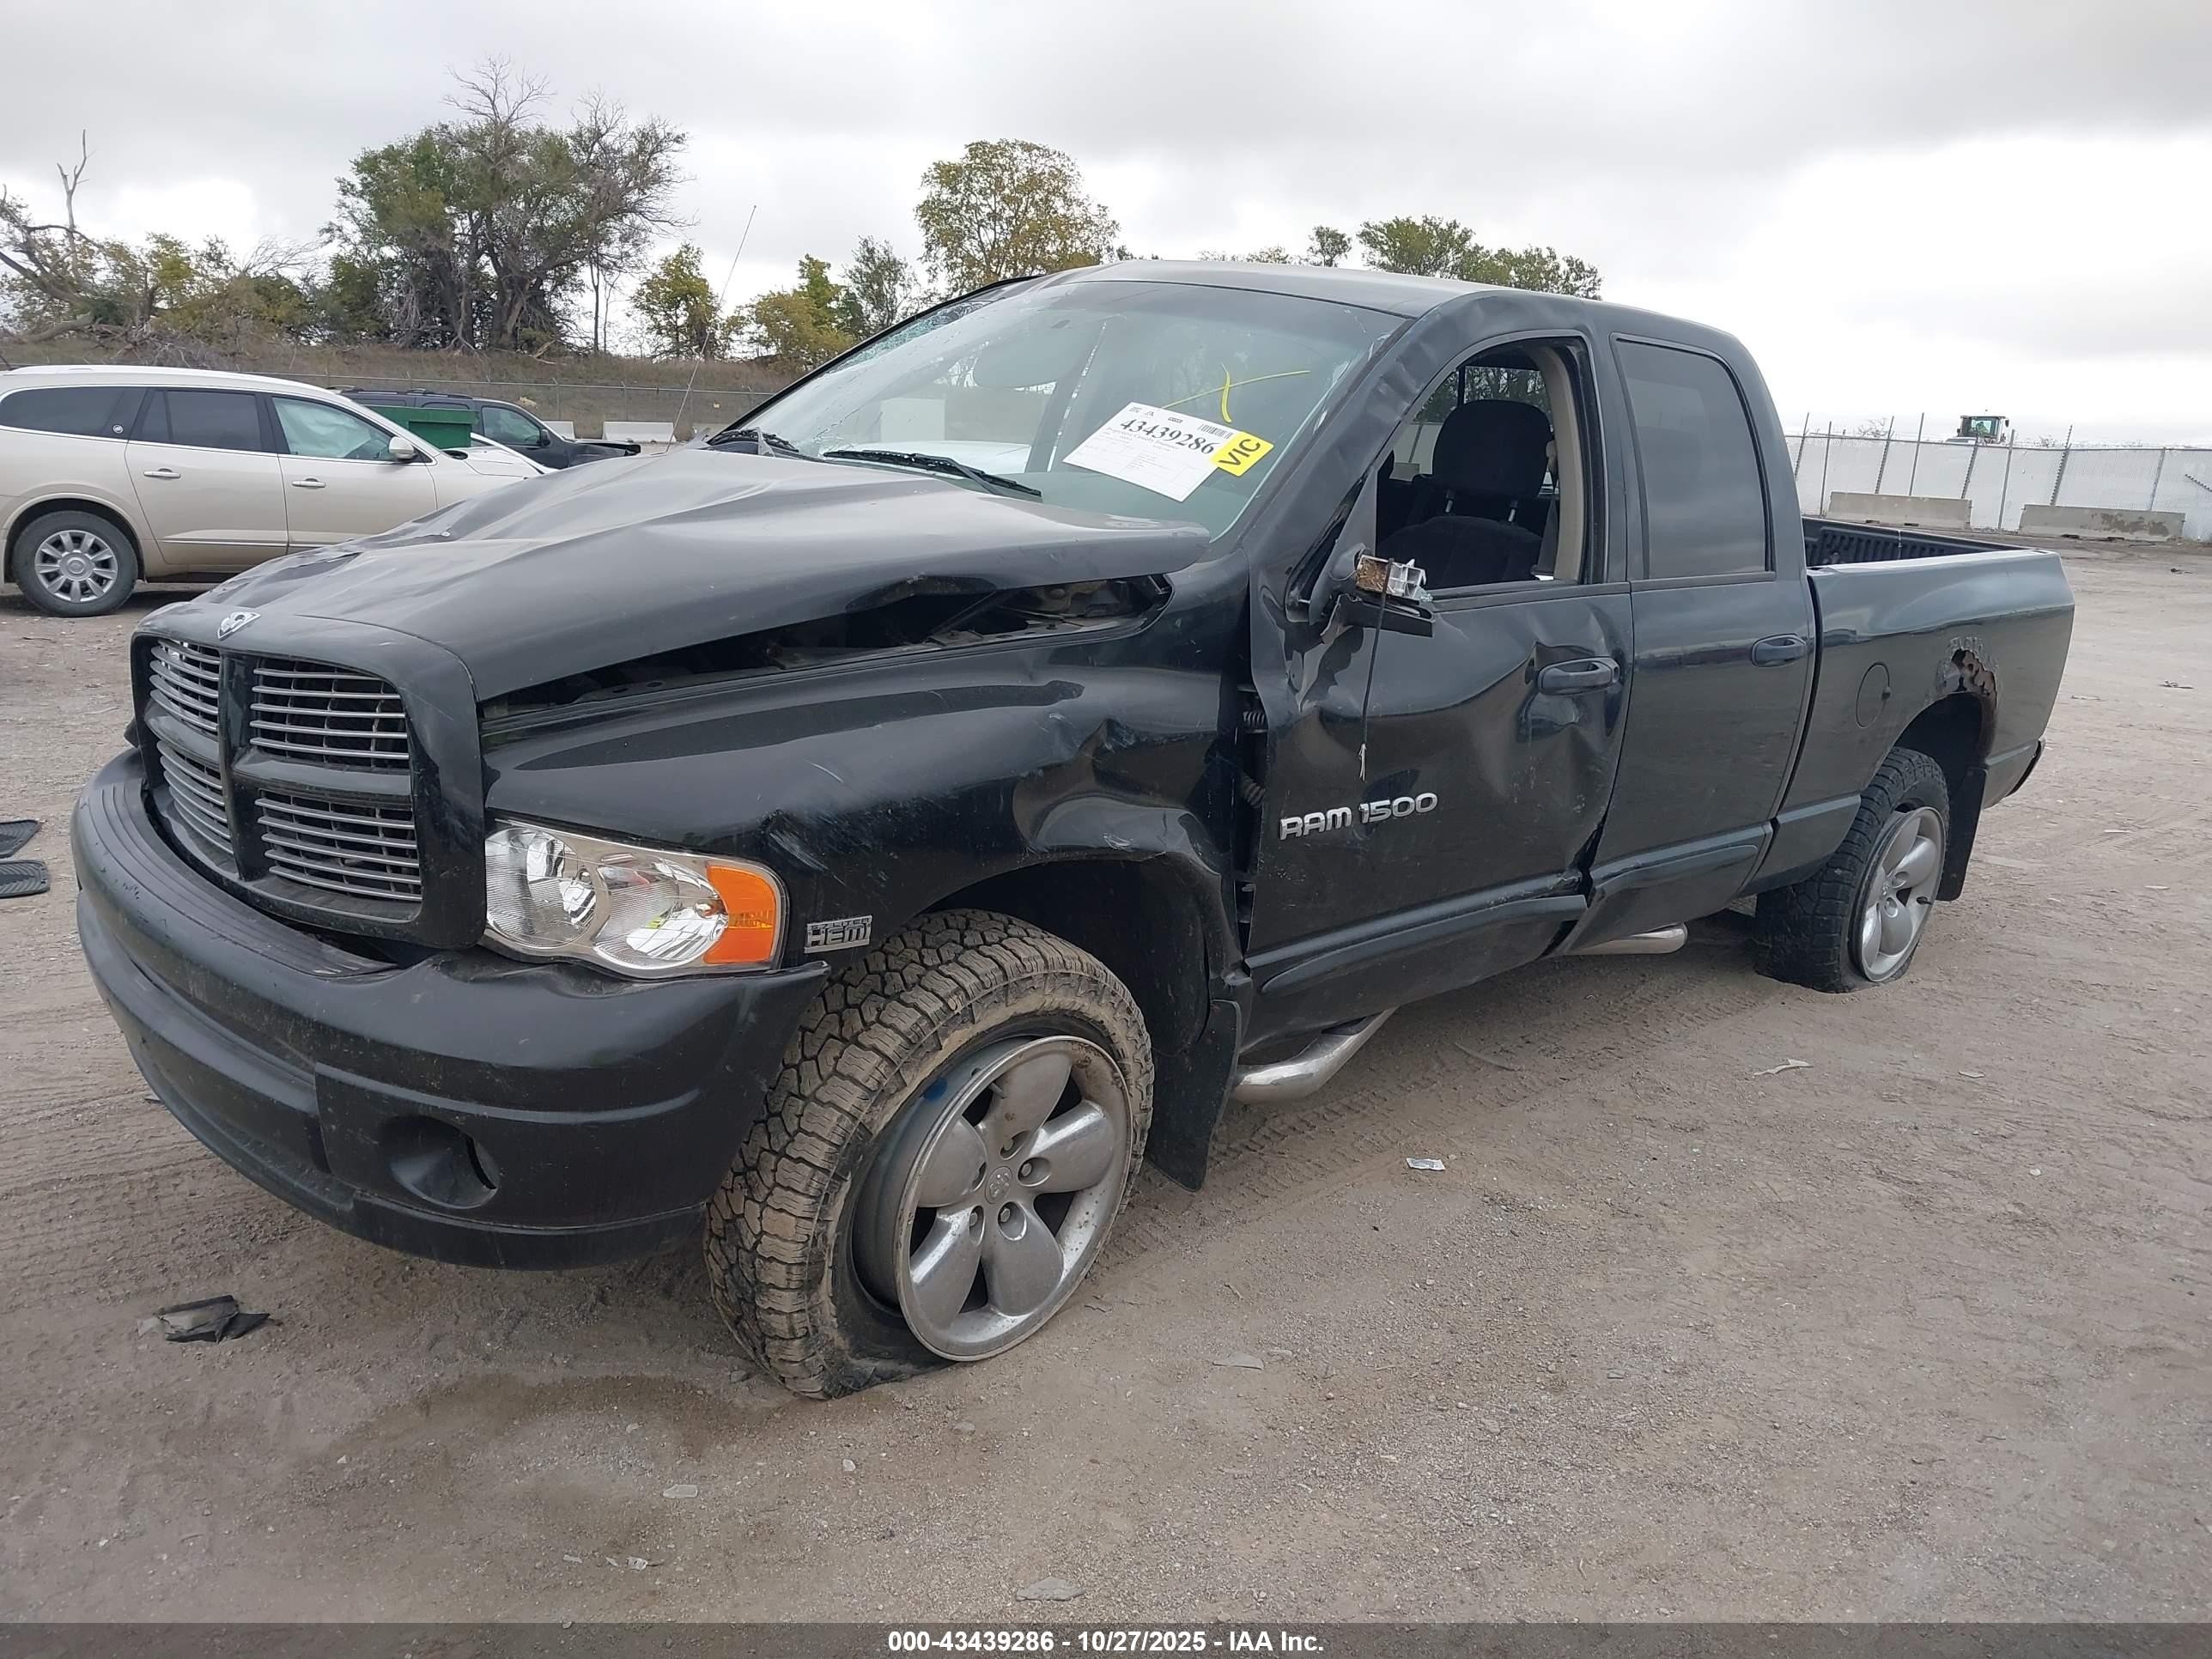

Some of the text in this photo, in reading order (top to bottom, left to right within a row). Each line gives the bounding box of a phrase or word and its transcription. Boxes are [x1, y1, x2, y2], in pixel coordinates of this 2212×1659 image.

[1120, 418, 1220, 455] 43439286
[1218, 438, 1261, 467] VIC
[1279, 793, 1438, 841] RAM 1500
[807, 923, 871, 947] HEMI
